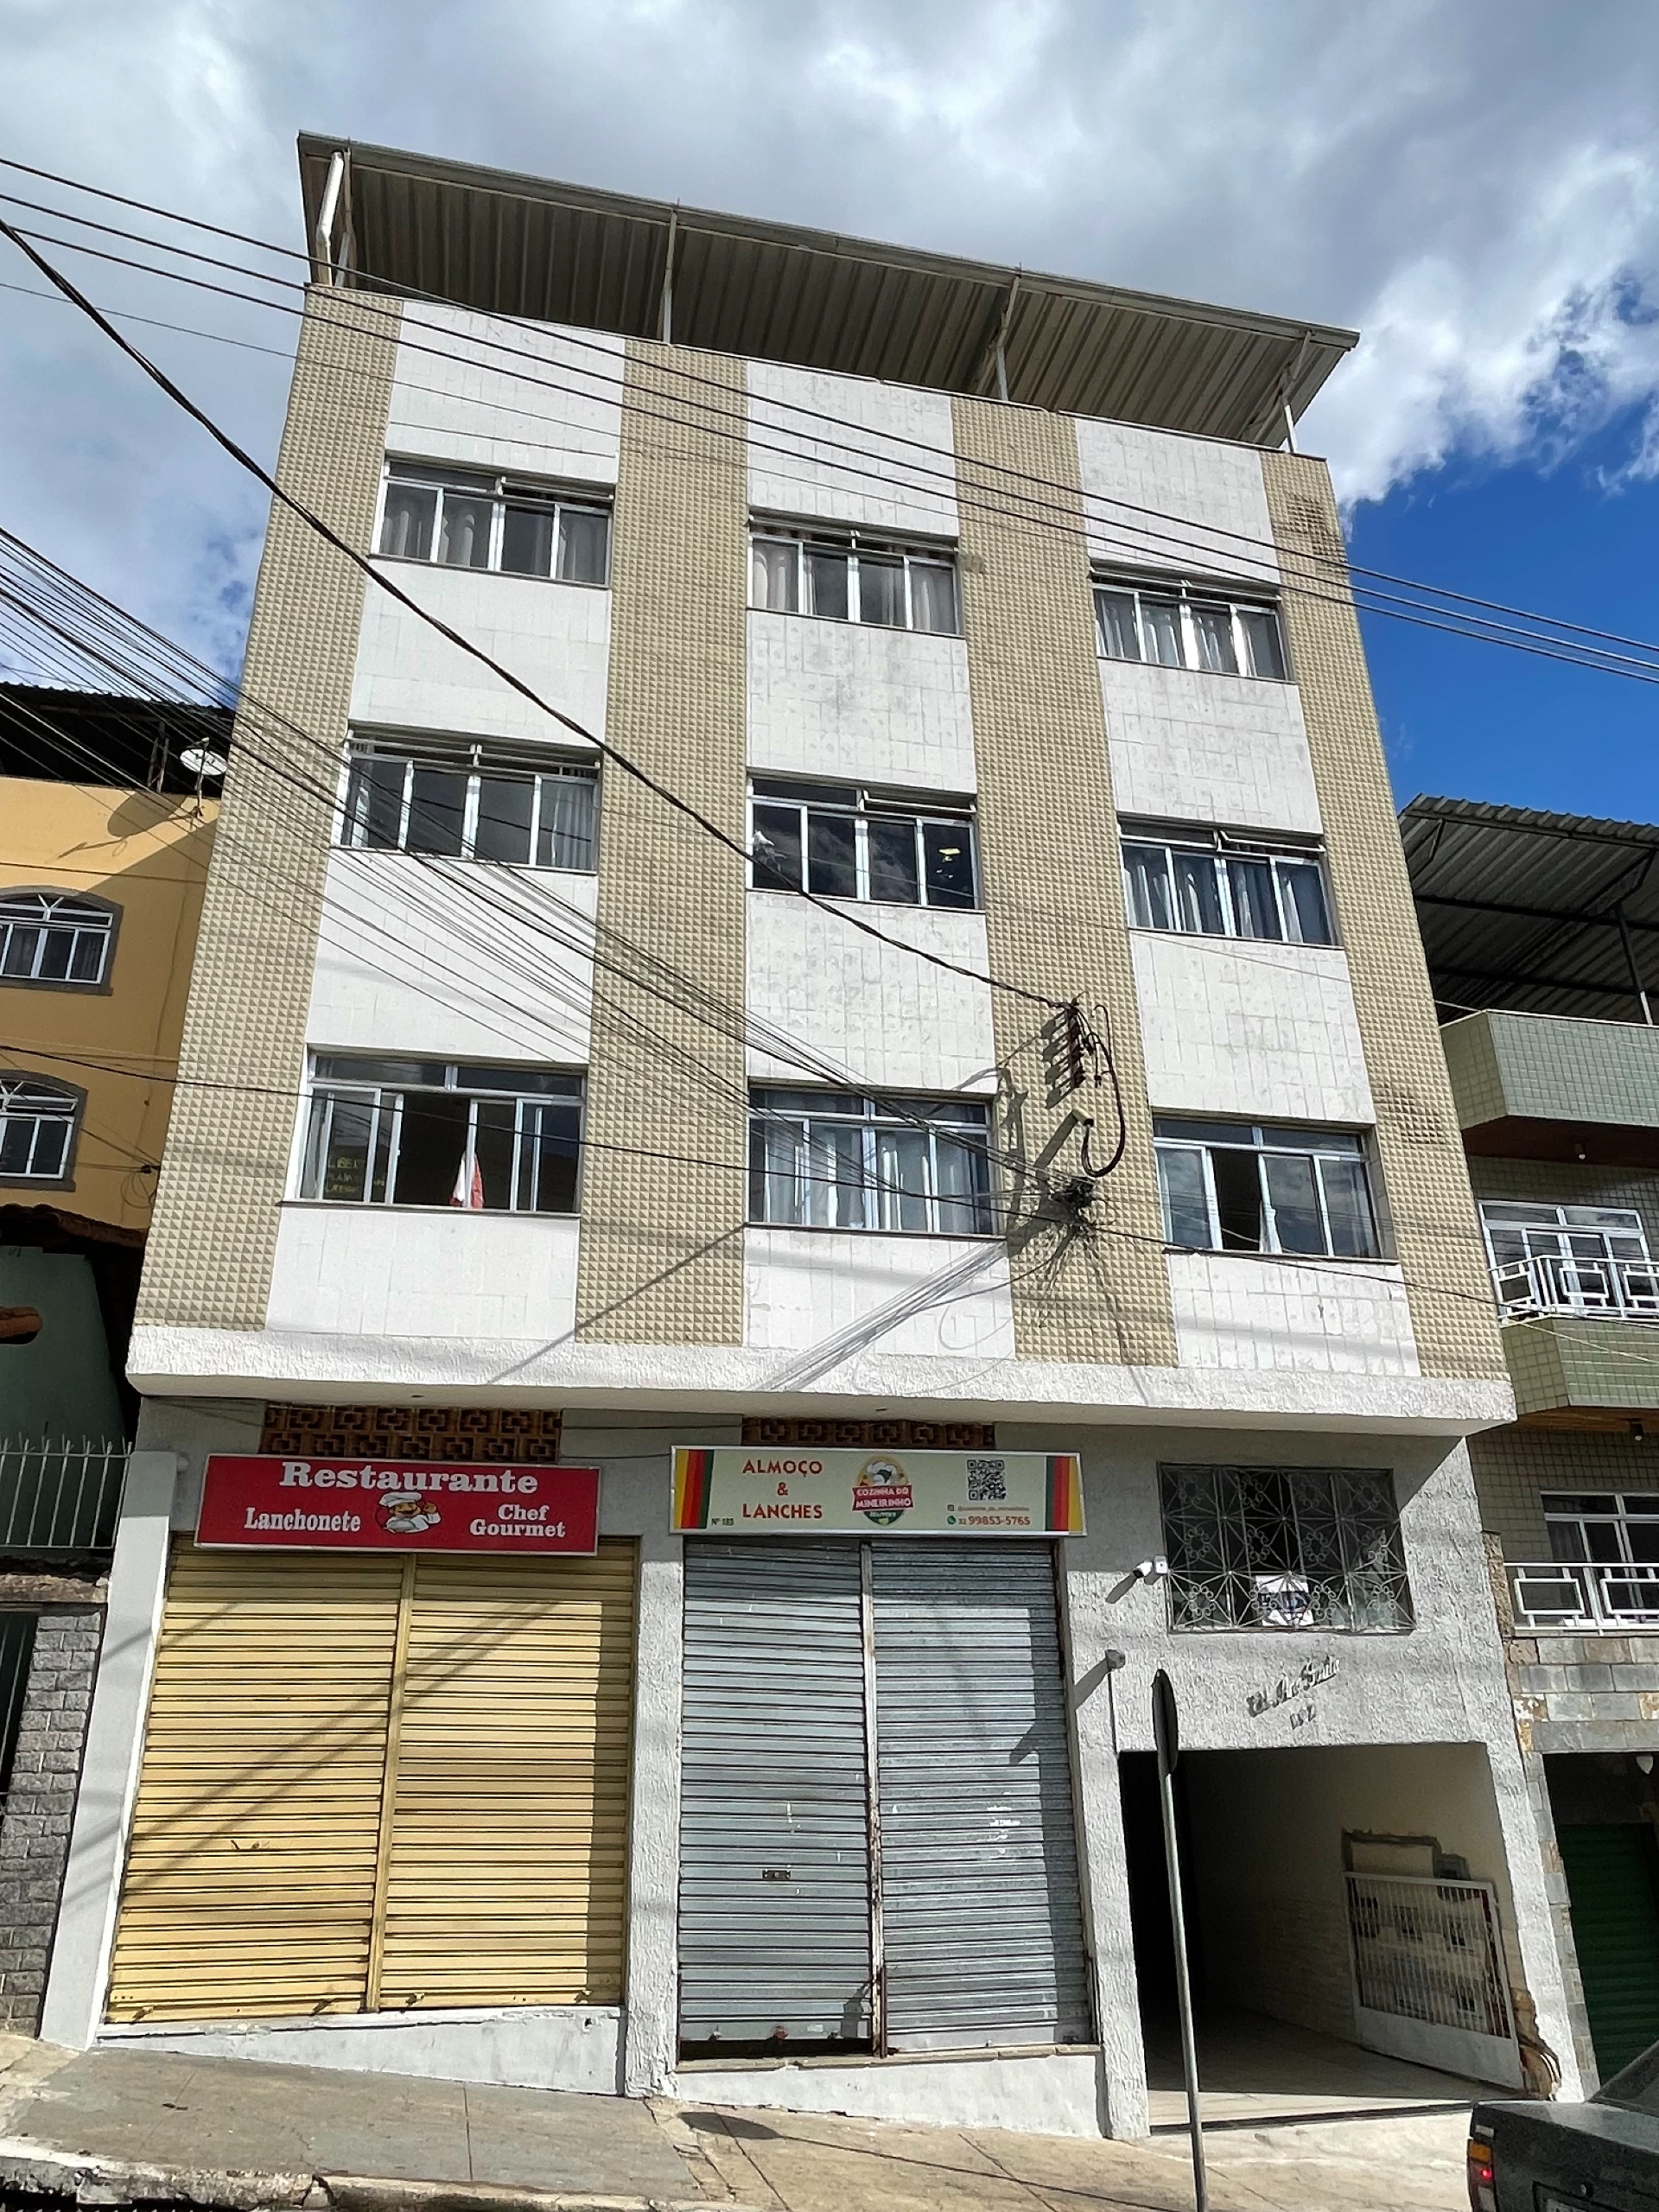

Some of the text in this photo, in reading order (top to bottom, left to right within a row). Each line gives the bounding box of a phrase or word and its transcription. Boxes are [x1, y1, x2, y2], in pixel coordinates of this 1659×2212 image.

[278, 1461, 538, 1494] Restaurante
[742, 1459, 823, 1478] ALMOÇO
[777, 1482, 788, 1496] &
[743, 1503, 823, 1518] LANCHES
[855, 1497, 911, 1508] MINEIRINHO
[244, 1506, 361, 1532] Lanchonete
[498, 1503, 550, 1521] Chef
[968, 1515, 1031, 1525] 99853-5765
[469, 1518, 566, 1537] Gourmet
